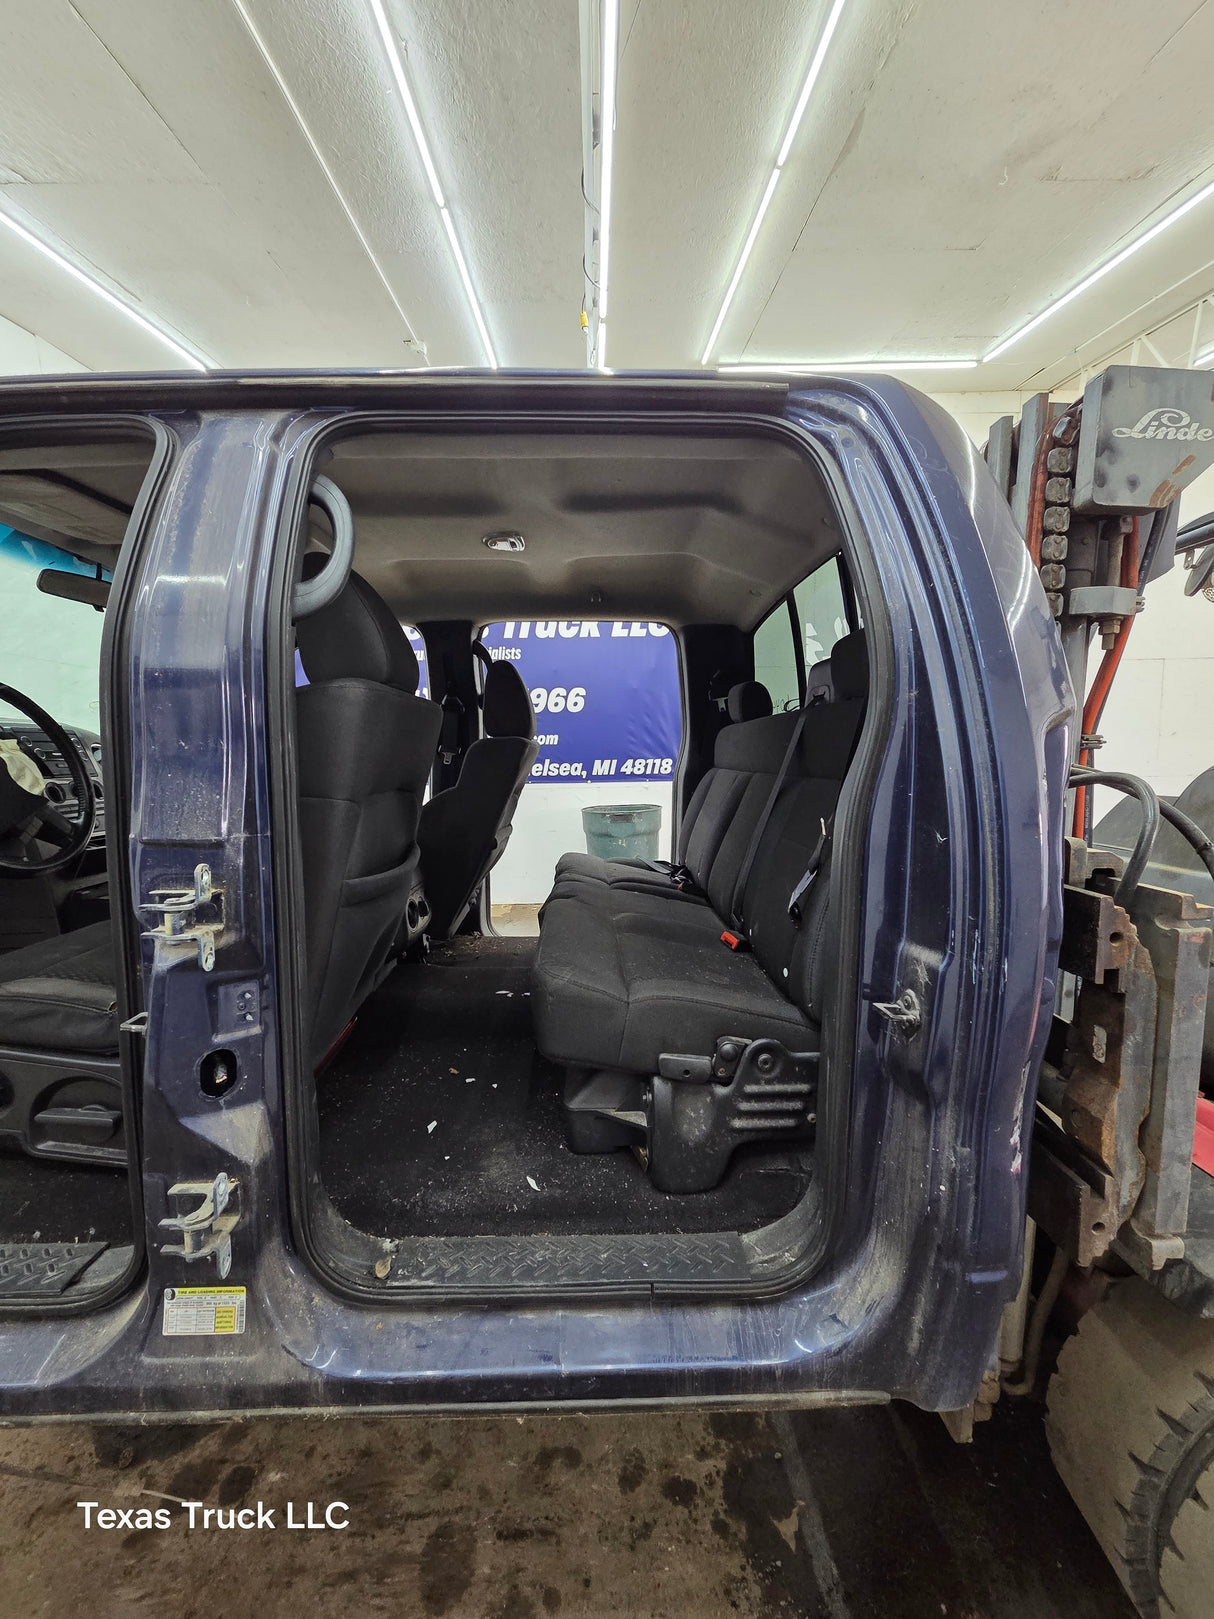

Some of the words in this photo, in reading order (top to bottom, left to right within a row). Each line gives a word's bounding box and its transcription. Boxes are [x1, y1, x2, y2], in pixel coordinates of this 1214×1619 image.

[1112, 408, 1214, 441] Linde
[528, 687, 587, 713] 966
[528, 758, 587, 779] elsea,
[592, 759, 618, 776] MI
[620, 758, 673, 775] 48118
